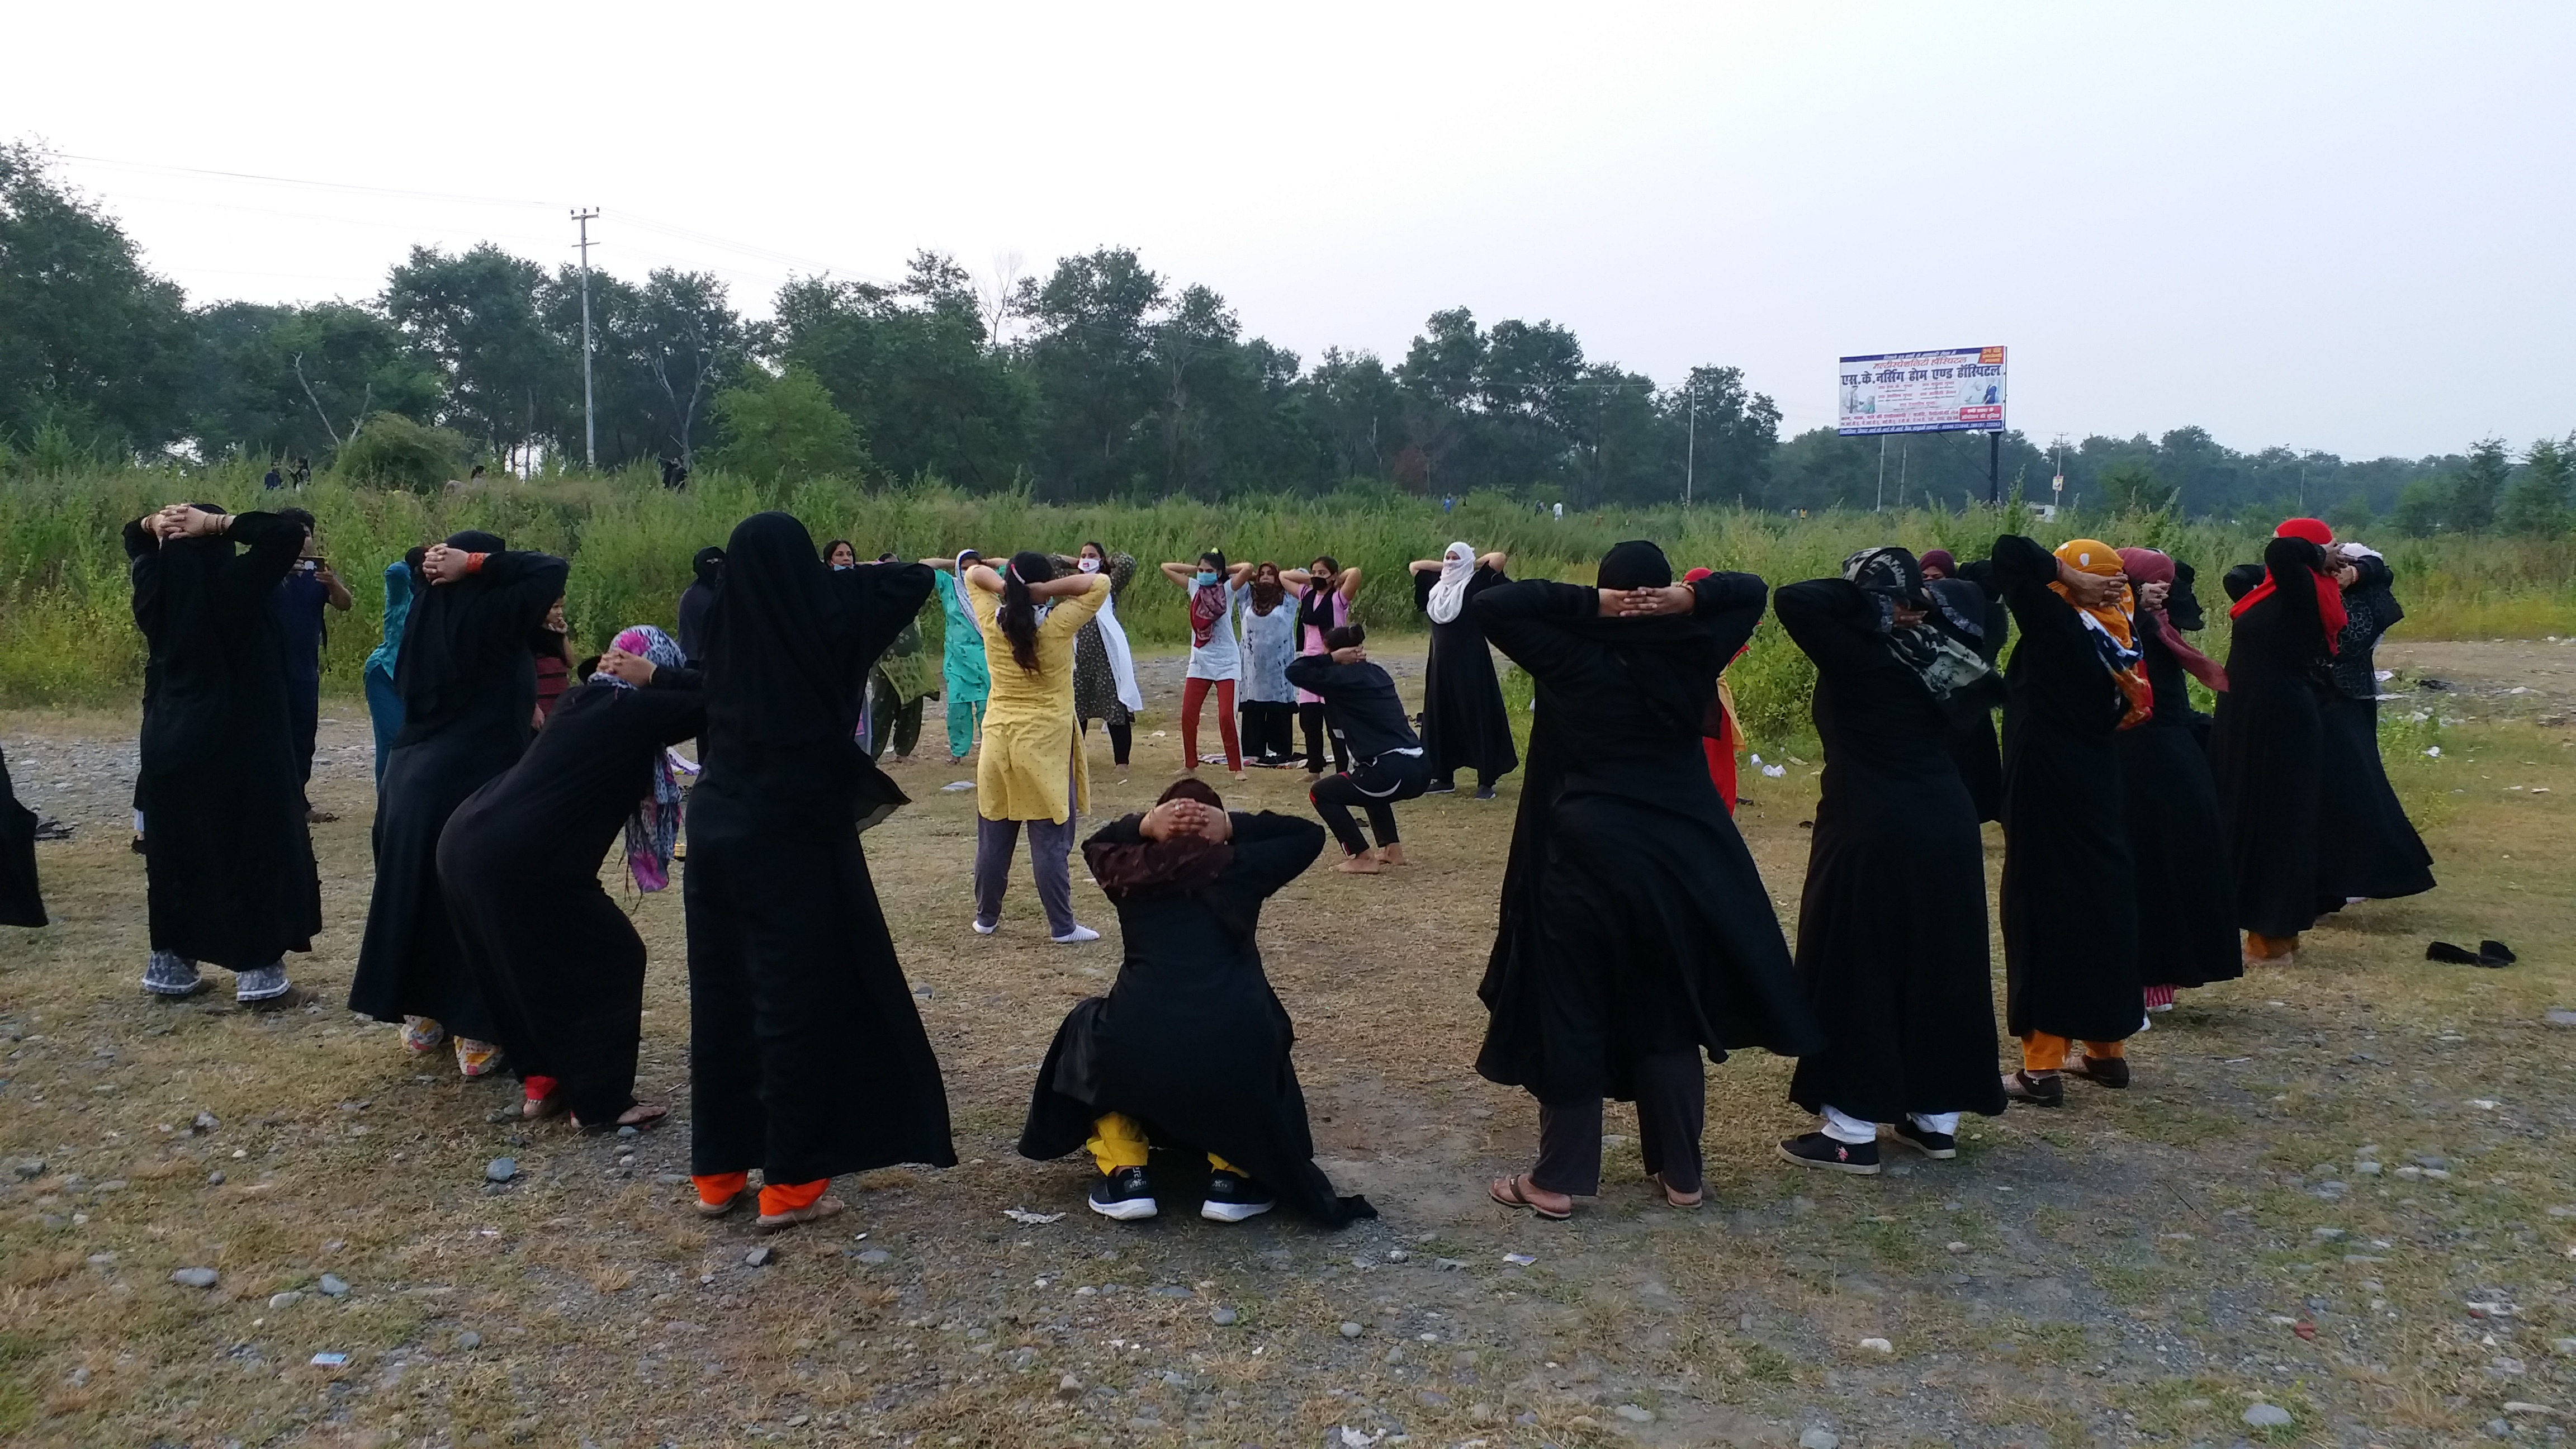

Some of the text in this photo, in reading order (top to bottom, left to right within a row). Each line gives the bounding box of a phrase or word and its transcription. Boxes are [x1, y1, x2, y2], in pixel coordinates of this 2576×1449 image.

[1908, 367, 1928, 381] होम
[1931, 368, 1953, 380] एण्ड
[1957, 363, 2001, 378] हॉस्पिटल
